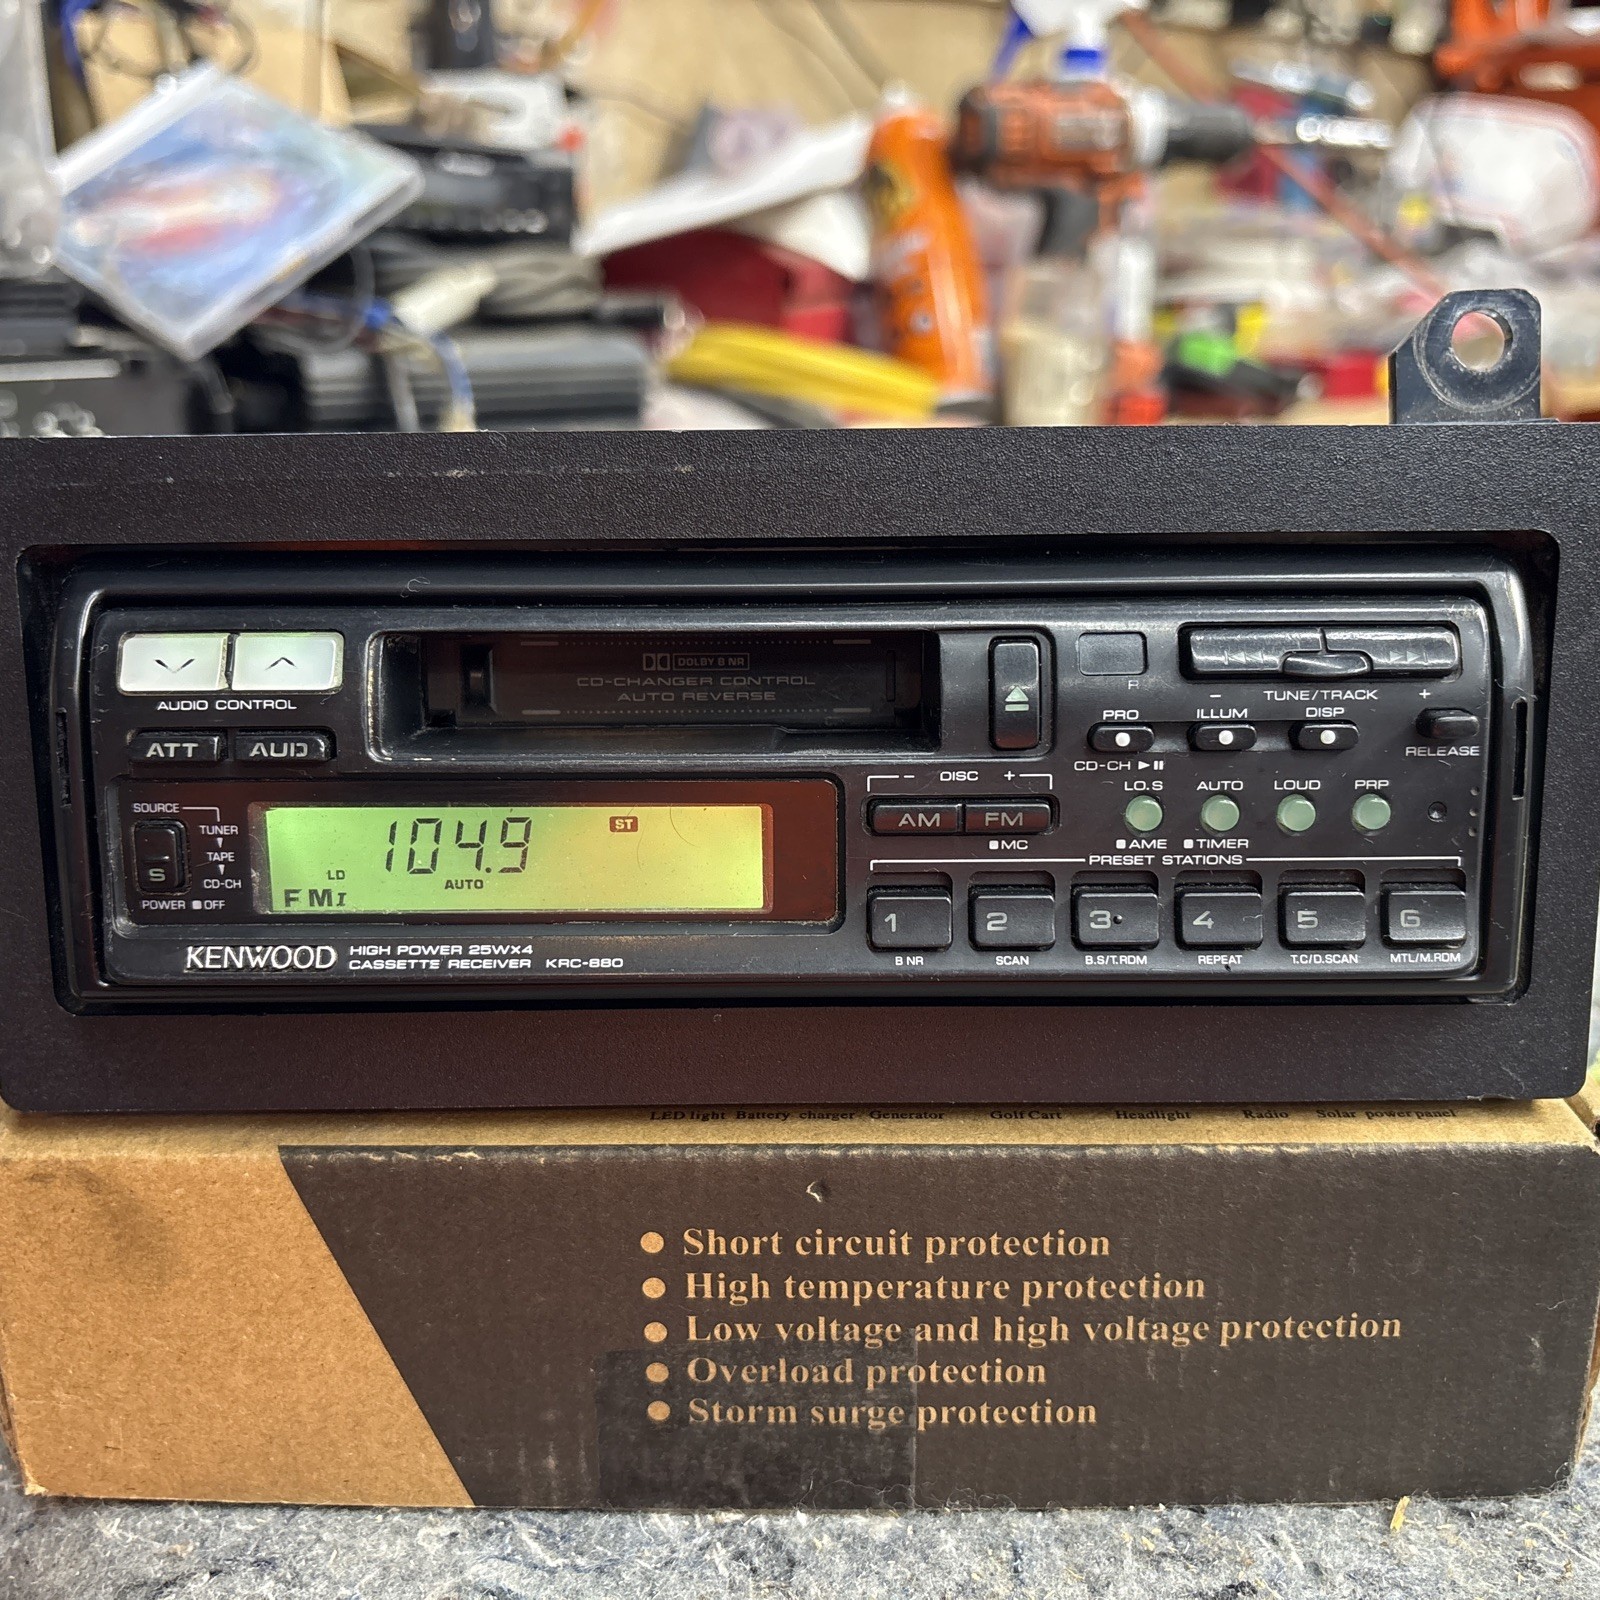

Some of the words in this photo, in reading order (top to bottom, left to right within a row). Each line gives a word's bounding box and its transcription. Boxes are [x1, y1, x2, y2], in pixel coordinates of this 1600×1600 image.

[678, 657, 715, 667] DOLBY
[718, 657, 725, 666] B
[728, 657, 745, 666] NR
[577, 676, 713, 687] CD-CHANGER
[720, 676, 816, 686] CONTROL
[617, 692, 675, 701] AUTO
[682, 692, 776, 700] REVERSE
[1263, 690, 1378, 700] TUNE/TRACK
[157, 700, 208, 710] AUDIO
[215, 699, 298, 710] CONTROL
[1102, 710, 1140, 720] PRO
[1196, 708, 1248, 718] ILLUM
[1306, 707, 1345, 718] DISP
[146, 742, 199, 758] ATT
[250, 742, 308, 757] AUD
[1405, 746, 1480, 757] RELEASE
[1074, 760, 1131, 771] CD-CH
[940, 771, 978, 782] DISC
[1124, 780, 1164, 791] LO.S
[1196, 780, 1243, 791] AUTO
[1274, 780, 1321, 790] LOUD
[1355, 780, 1390, 790] PRP
[133, 803, 180, 813] SOURCE
[614, 818, 634, 830] ST
[898, 813, 941, 828] AM
[984, 812, 1024, 827] FM
[200, 825, 239, 835] TUNER
[385, 816, 532, 874] 104.9
[1001, 840, 1028, 850] MC
[1129, 839, 1168, 849] AME
[1196, 839, 1249, 848] TIMER
[206, 852, 235, 862] TAPE
[1089, 855, 1155, 865] PRESET
[1162, 855, 1243, 865] STATIONS
[148, 868, 166, 882] S
[327, 869, 345, 880] LD
[203, 879, 242, 889] CD-CH
[444, 879, 484, 890] AUTO
[142, 900, 186, 910] POWER
[204, 900, 226, 909] OFF
[884, 913, 897, 932] 1
[986, 912, 1008, 931] 2
[1089, 910, 1111, 929] 3
[1192, 910, 1215, 929] 4
[1297, 910, 1319, 930] 5
[1400, 909, 1421, 928] 6
[350, 946, 390, 956] HIGH
[397, 945, 463, 955] POWER
[186, 945, 337, 970] KENWOOD
[895, 956, 904, 965] B
[906, 956, 924, 965] NR
[995, 956, 1029, 965] SCAN
[1085, 955, 1148, 965] B.S/T.RDM
[1198, 955, 1242, 965] REPEAT
[1290, 954, 1359, 964] T.C/D.SCAN
[1390, 952, 1461, 963] MTL/M.RDM
[349, 959, 440, 970] CASSETTE
[448, 959, 531, 969] RECEIVER
[546, 958, 624, 968] KRC-880
[650, 1110, 686, 1120] LED
[690, 1110, 726, 1121] light
[736, 1110, 790, 1121] Battery
[799, 1110, 856, 1121] charger
[869, 1110, 945, 1120] Generator
[990, 1110, 1026, 1120] Golf
[1028, 1110, 1063, 1120] Cart
[1114, 1110, 1192, 1121] Headlight
[1242, 1109, 1289, 1119] Radio
[1316, 1109, 1356, 1119] Solar
[1365, 1110, 1412, 1120] power
[1414, 1109, 1457, 1119] panel
[683, 1228, 783, 1256] Short
[795, 1228, 913, 1256] circuit
[924, 1228, 1110, 1263] protection
[685, 1272, 770, 1306] High
[784, 1274, 1010, 1306] temperature
[1022, 1272, 1205, 1307] protection
[686, 1315, 762, 1342] Low
[775, 1315, 902, 1349] voltage
[915, 1316, 979, 1342] and
[994, 1315, 1070, 1349] high
[1084, 1315, 1209, 1347] voltage
[1219, 1312, 1402, 1347] protection
[687, 1357, 854, 1384] Overload
[866, 1358, 1046, 1390] protection
[688, 1398, 798, 1425] Storm
[810, 1405, 905, 1430] surge
[916, 1398, 1097, 1431] protection
